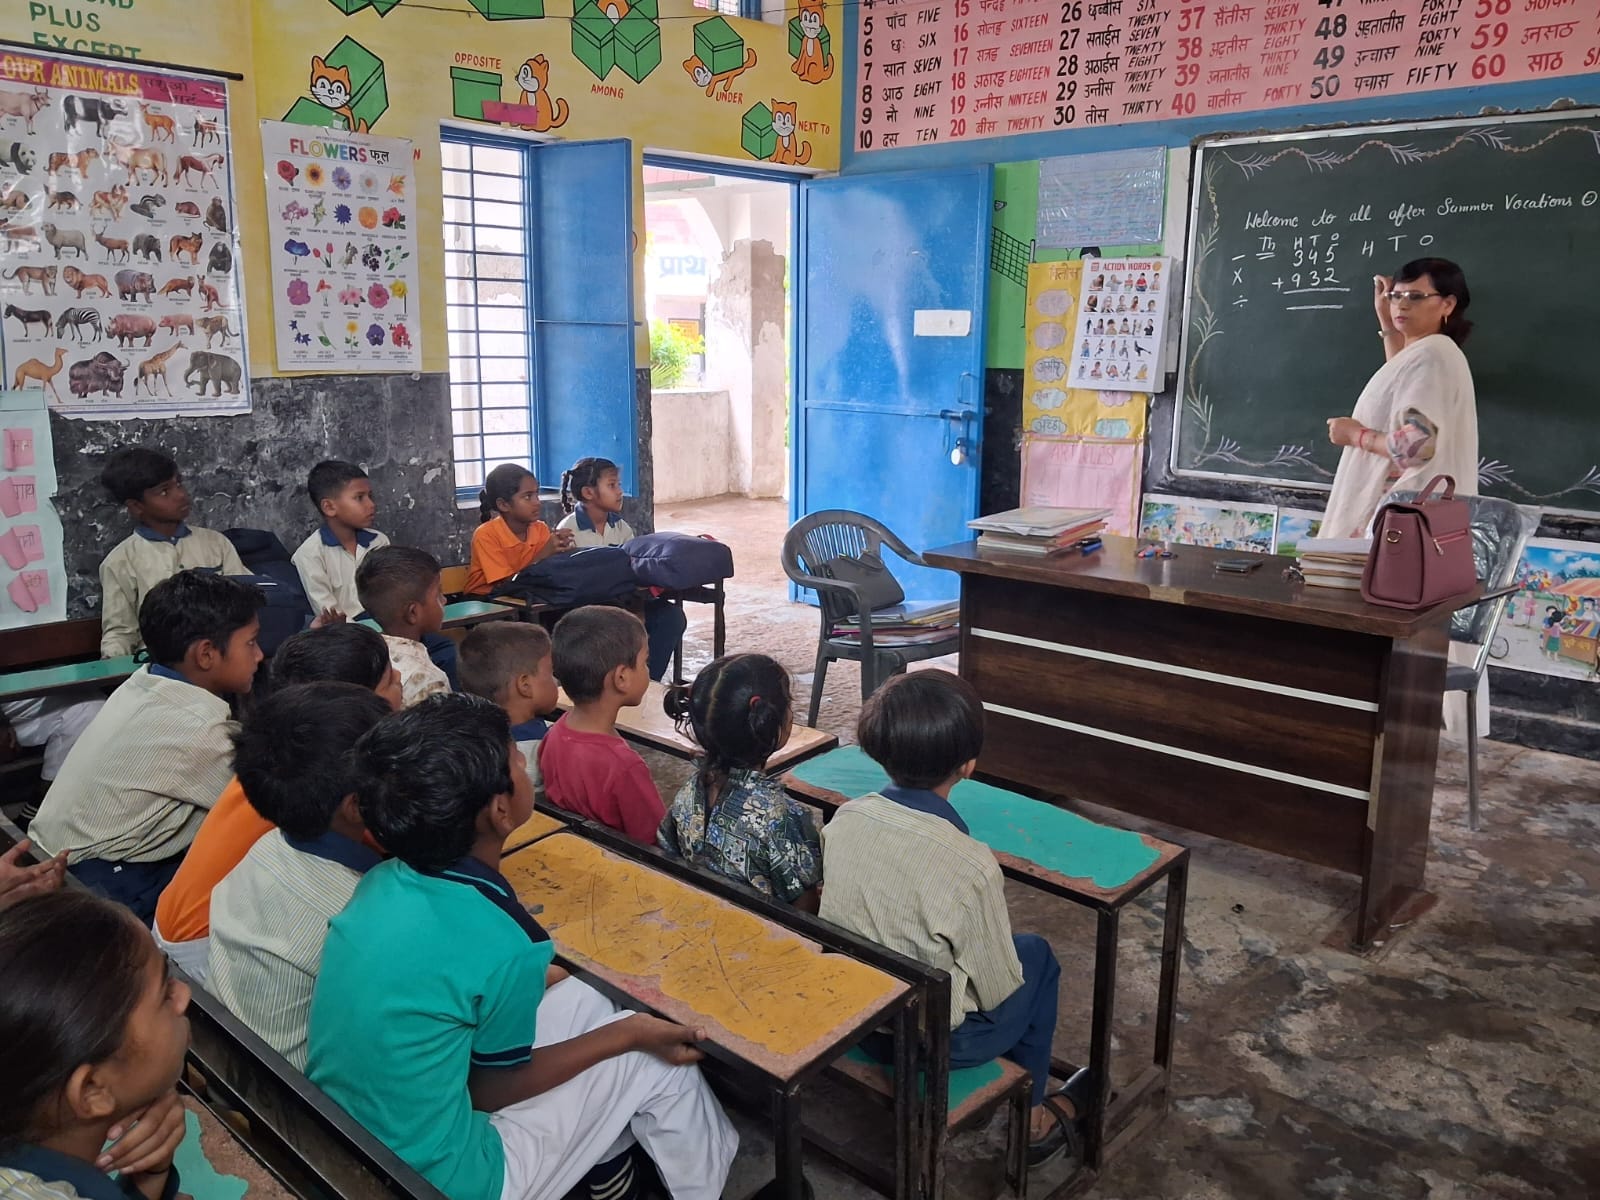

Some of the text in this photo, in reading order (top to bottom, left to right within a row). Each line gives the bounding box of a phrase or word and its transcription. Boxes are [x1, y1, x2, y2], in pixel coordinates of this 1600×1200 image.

[29, 1, 101, 32] PLUS
[954, 0, 969, 18] 15
[1061, 1, 1082, 23] 26
[1128, 9, 1171, 27] TWENTY
[1178, 6, 1205, 31] 37
[1264, 3, 1299, 20] SEVEN
[1418, 10, 1458, 27] EIGHT
[864, 17, 873, 35] 5
[917, 8, 941, 24] FIVE
[954, 23, 968, 43] 16
[1011, 13, 1048, 31] SIXTEEN
[1264, 18, 1307, 35] THIRTY
[1314, 14, 1347, 40] 48
[864, 39, 873, 56] 6
[918, 32, 937, 48] SIX
[1060, 28, 1080, 50] 27
[1129, 26, 1160, 41] SEVEN
[1264, 34, 1301, 49] EIGHT
[1419, 27, 1460, 45] FORTY
[1471, 22, 1509, 50] 59
[954, 47, 968, 66] 17
[1010, 39, 1053, 57] SEVENTEEN
[1125, 40, 1166, 56] TWENTY
[1176, 36, 1203, 61] 38
[1261, 49, 1300, 64] THIRTY
[1313, 45, 1345, 70] 49
[1415, 43, 1445, 57] NINE
[455, 52, 501, 69] OPPOSITE
[864, 56, 942, 80] 7 सात SEVEN
[1056, 54, 1078, 76] 28
[1128, 54, 1161, 68] EIGHT
[1263, 63, 1290, 76] NINE
[1472, 54, 1505, 79] 60
[1527, 51, 1564, 72] साठ
[3, 54, 140, 95] OUR ANIMALS
[952, 72, 966, 90] 18
[1009, 66, 1051, 83] EIGHTEEN
[1124, 68, 1167, 82] TWENTY
[1175, 63, 1201, 86] 39
[1310, 62, 1457, 99] 50 पचास FIFTY
[591, 84, 625, 99] AMONG
[715, 91, 743, 104] UNDER
[862, 81, 942, 103] 8 आठ EIGHT
[1056, 80, 1077, 101] 29
[1128, 82, 1153, 93] NINE
[951, 95, 965, 114] 19
[1172, 92, 1196, 115] 40
[1263, 84, 1302, 102] FORTY
[862, 104, 936, 124] 9 नौ NINE
[1054, 99, 1162, 125] 30 तीस THIRTY
[799, 121, 830, 134] NEXT TO
[950, 115, 1045, 136] 20 बीस TWENTY
[860, 128, 938, 148] 10 दस TEN
[290, 138, 368, 163] FLOWERS
[370, 149, 390, 165] फूल
[1245, 209, 1299, 230] Welcome
[1312, 209, 1336, 226] to
[1350, 204, 1372, 222] all
[1389, 203, 1425, 227] after
[1437, 197, 1493, 216] Summer
[1258, 236, 1276, 251] Th
[1294, 237, 1302, 250] H
[1310, 234, 1321, 246] T
[1362, 240, 1374, 258] H
[1388, 235, 1408, 252] T
[1103, 262, 1151, 271] ACTION WORDS
